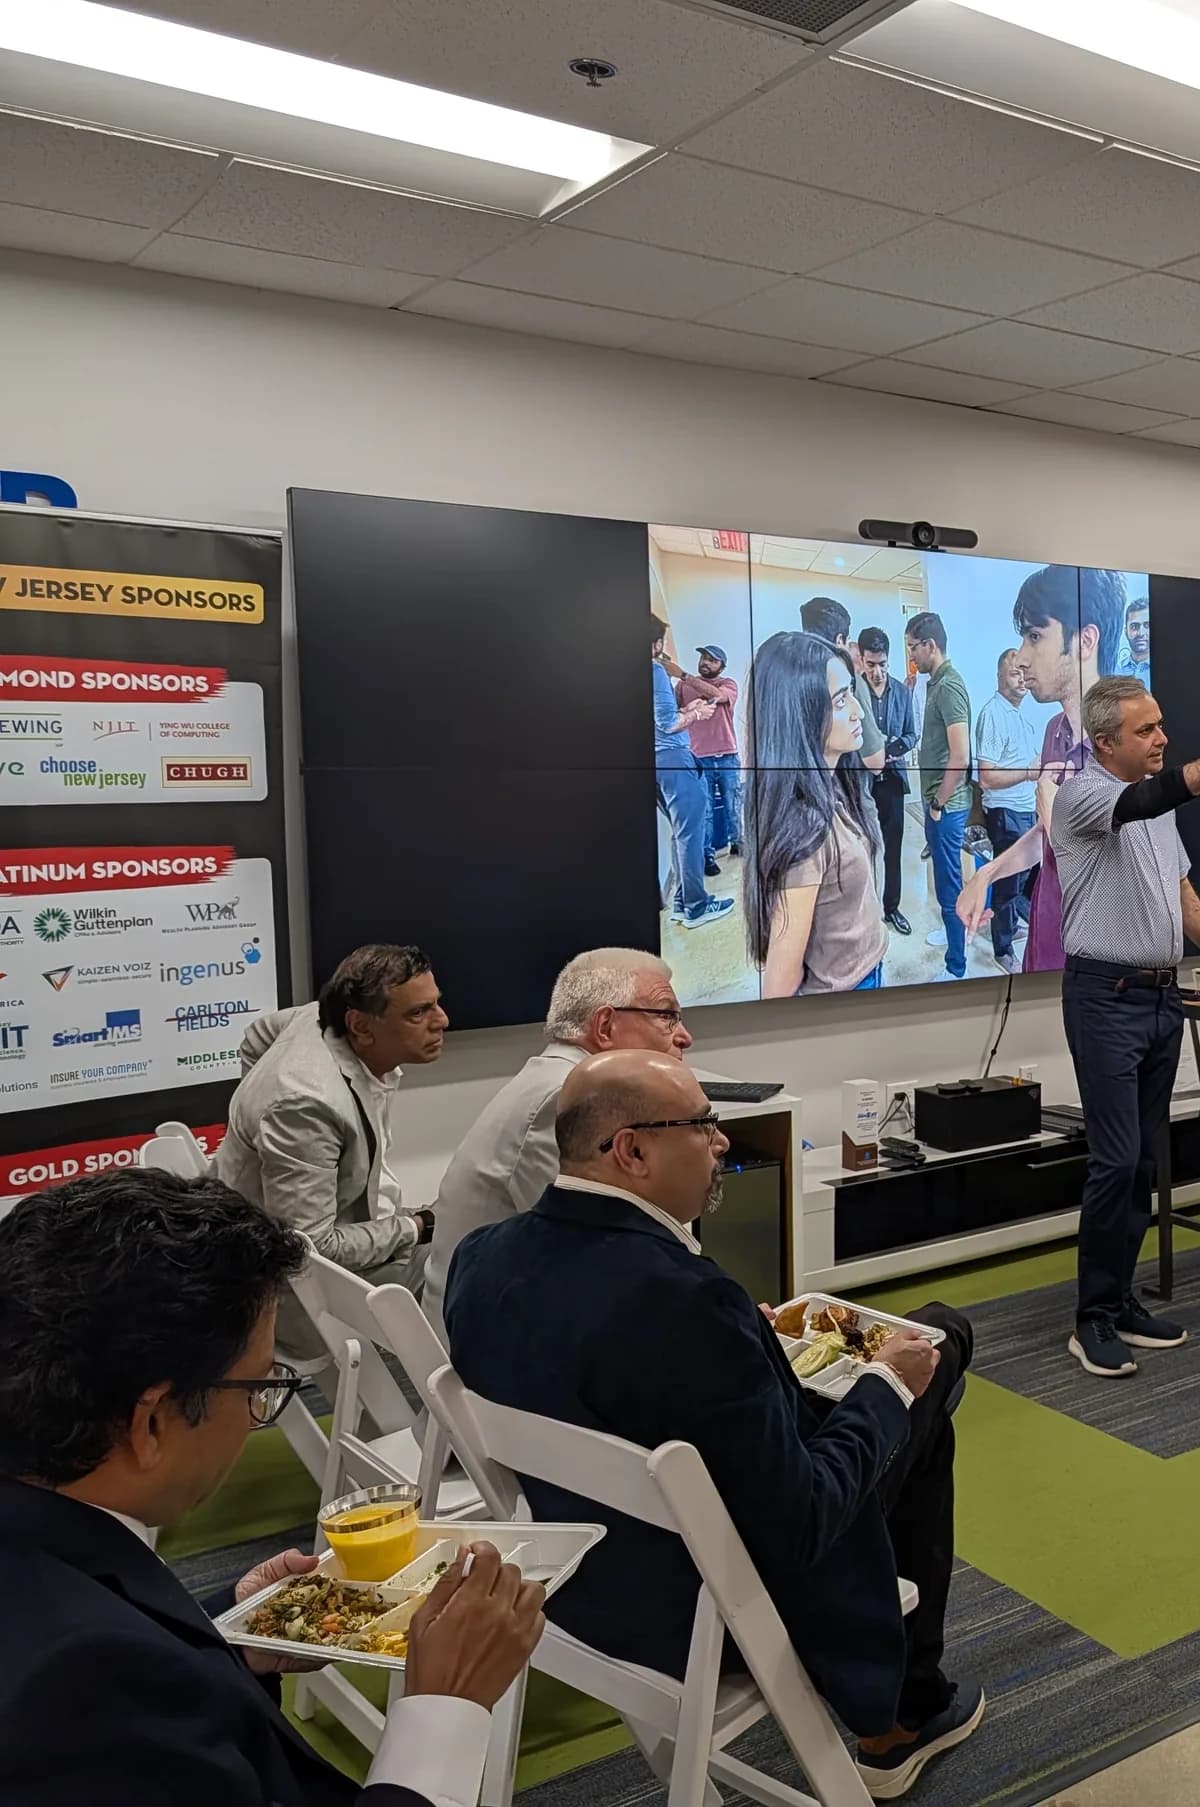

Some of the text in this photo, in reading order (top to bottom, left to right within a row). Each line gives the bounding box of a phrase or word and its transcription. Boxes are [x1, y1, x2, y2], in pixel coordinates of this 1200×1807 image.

[15, 578, 114, 602] JERSEY
[121, 585, 256, 612] SPONSORS
[81, 672, 209, 692] SPONSORS
[93, 721, 136, 732] NJIT
[196, 722, 231, 730] COLLEGE
[40, 756, 97, 773] choose
[169, 766, 245, 778] CHUGH
[64, 769, 146, 789] new jersey
[92, 857, 217, 878] SPONSORS
[73, 907, 117, 920] Wilkin
[0, 916, 21, 935] A
[74, 917, 154, 931] Guttenplan
[78, 962, 152, 977] KAIZEN VOIZ
[160, 961, 246, 985] ingenus
[175, 1000, 249, 1020] CARLTON
[177, 1014, 231, 1032] FIELDS
[177, 1049, 241, 1066] MIDDLESE
[50, 1070, 79, 1084] INSURE
[81, 1067, 105, 1079] YOUR
[106, 1061, 148, 1075] COMPANY
[8, 1159, 79, 1186] GOLD
